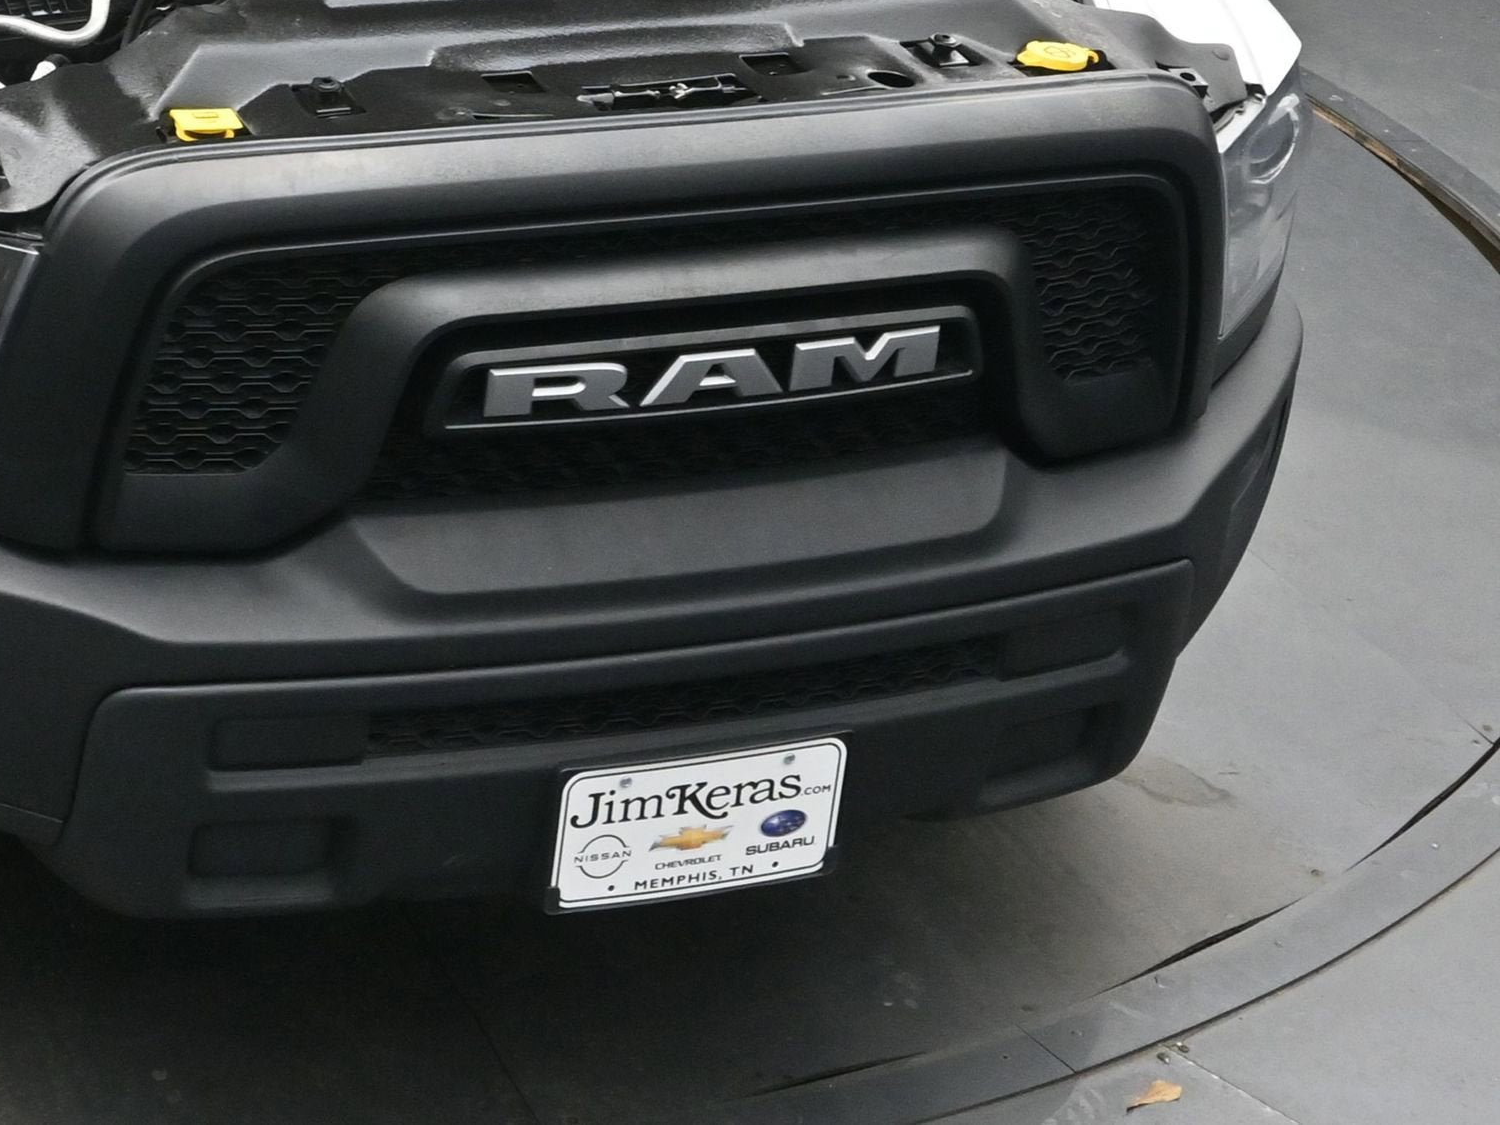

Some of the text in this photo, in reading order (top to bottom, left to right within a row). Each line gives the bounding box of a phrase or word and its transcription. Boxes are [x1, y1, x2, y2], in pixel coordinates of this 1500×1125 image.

[483, 325, 941, 418] RAM
[745, 836, 815, 856] SUBARU
[574, 850, 632, 864] NISSAN
[654, 854, 723, 871] CHEVROLET
[634, 864, 755, 891] MEMPHIS, TN
